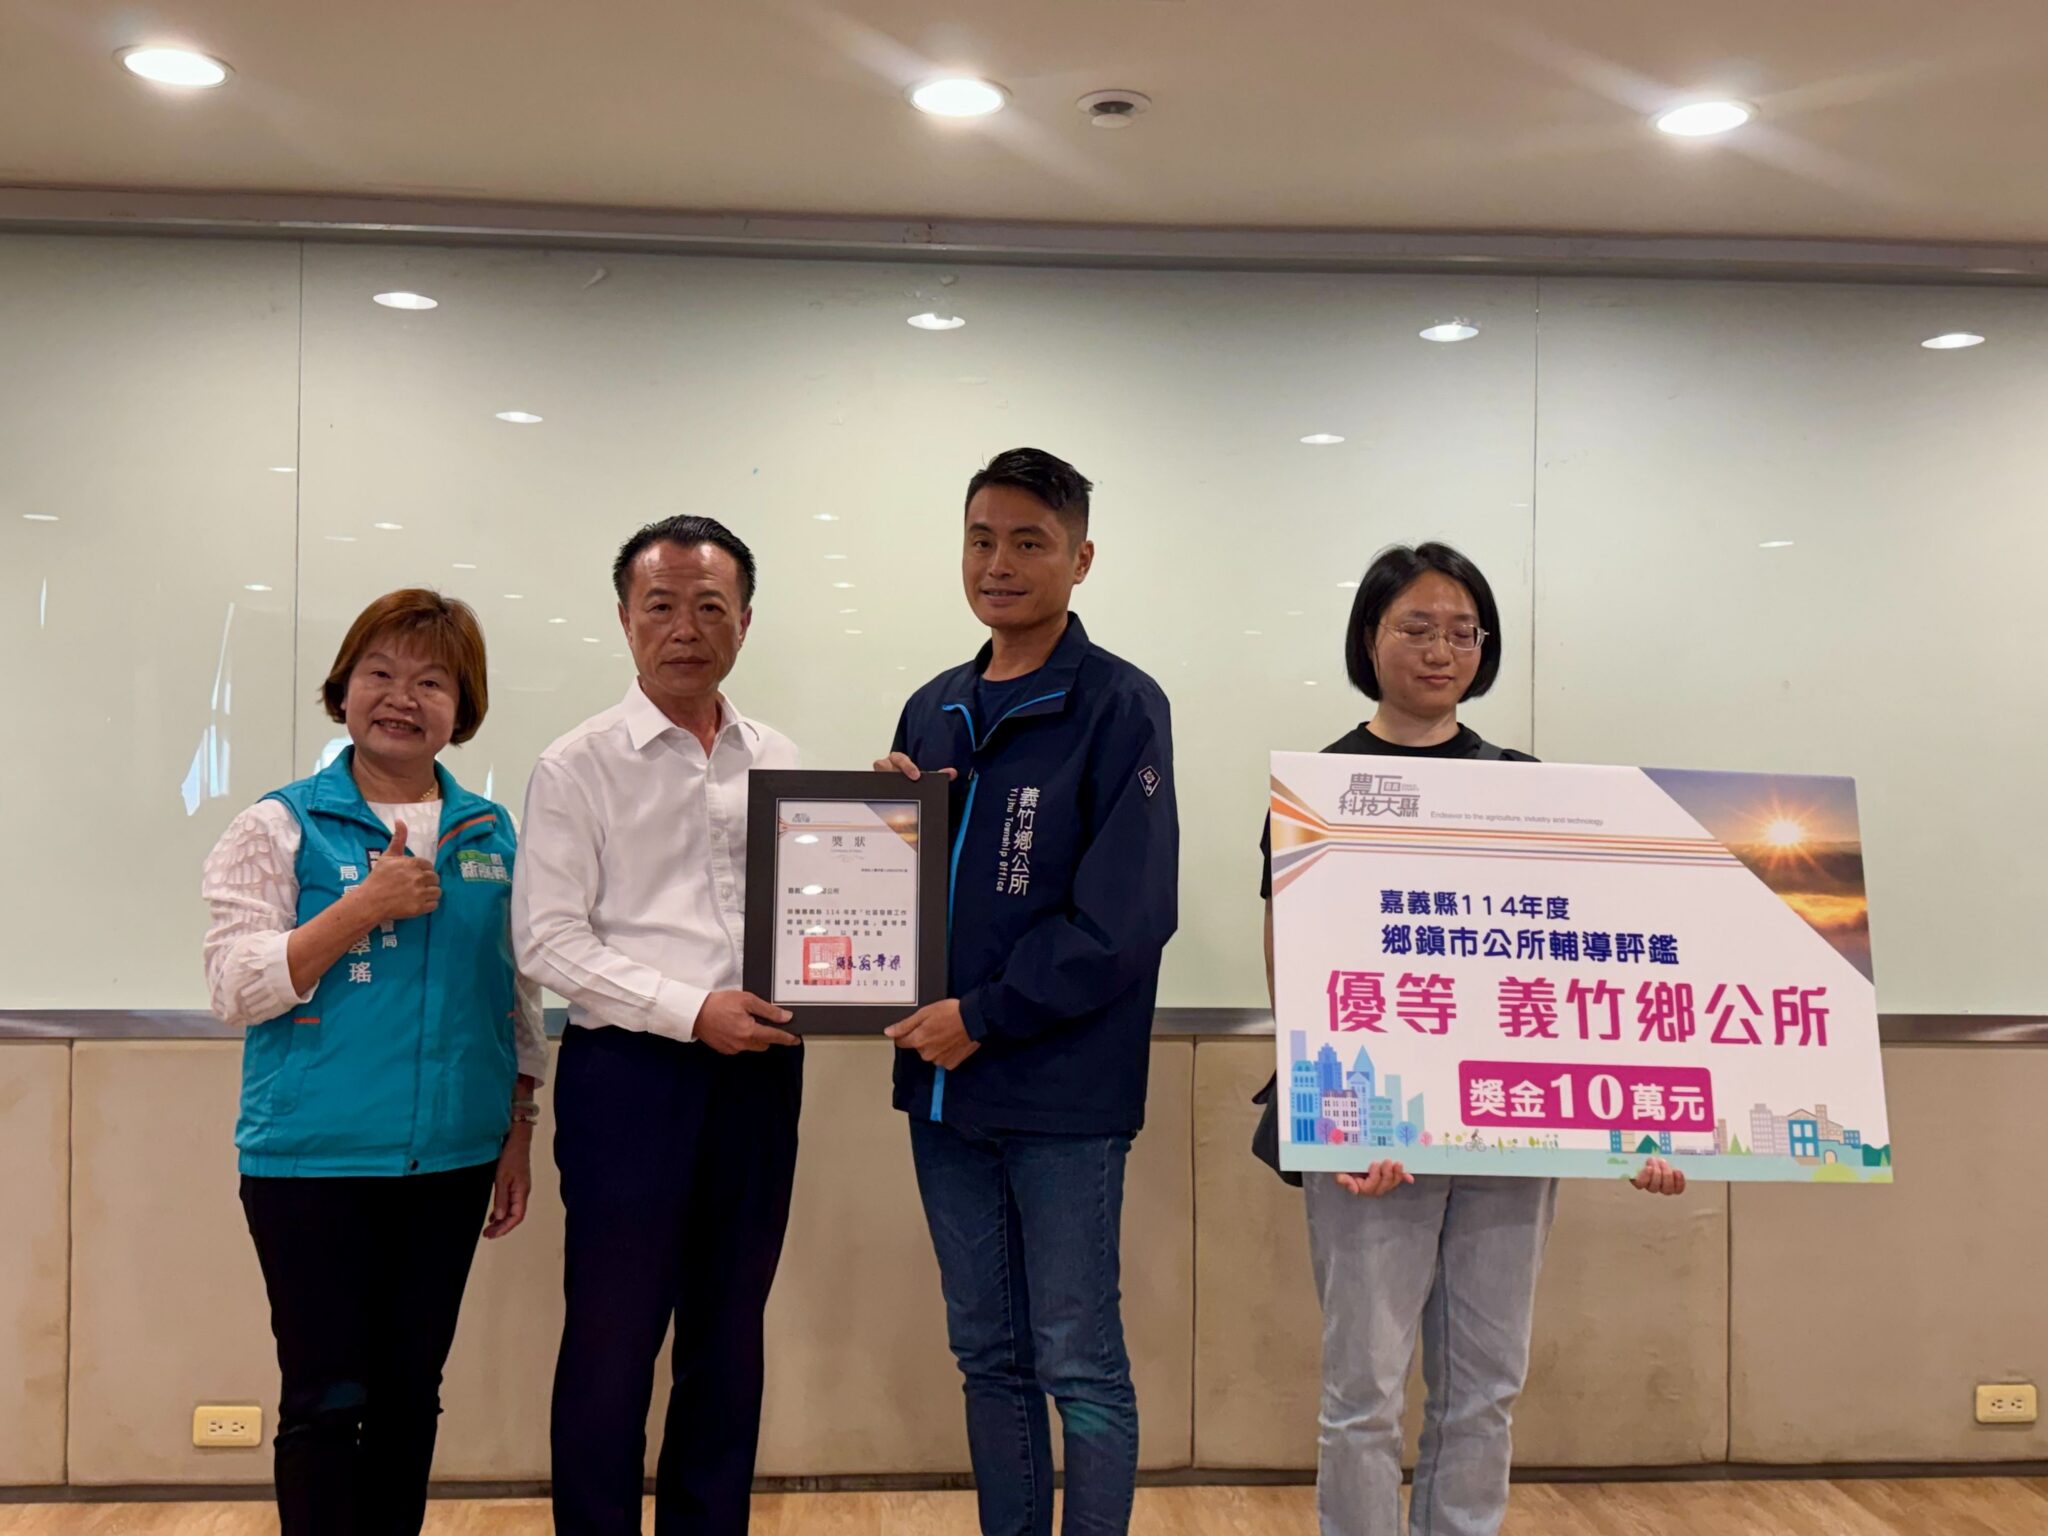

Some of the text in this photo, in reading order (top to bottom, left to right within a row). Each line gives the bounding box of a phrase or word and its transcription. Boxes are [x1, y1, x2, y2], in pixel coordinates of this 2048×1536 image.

[1338, 795, 1419, 817] 科技大縣
[996, 788, 1019, 892] Yijhu Township Office
[1006, 786, 1041, 896] 義竹鄉公所
[1380, 889, 1571, 921] 嘉義縣114年度
[1326, 969, 1830, 1047] 優等 義竹鄉公所
[1469, 1073, 1705, 1121] 獎金10萬元
